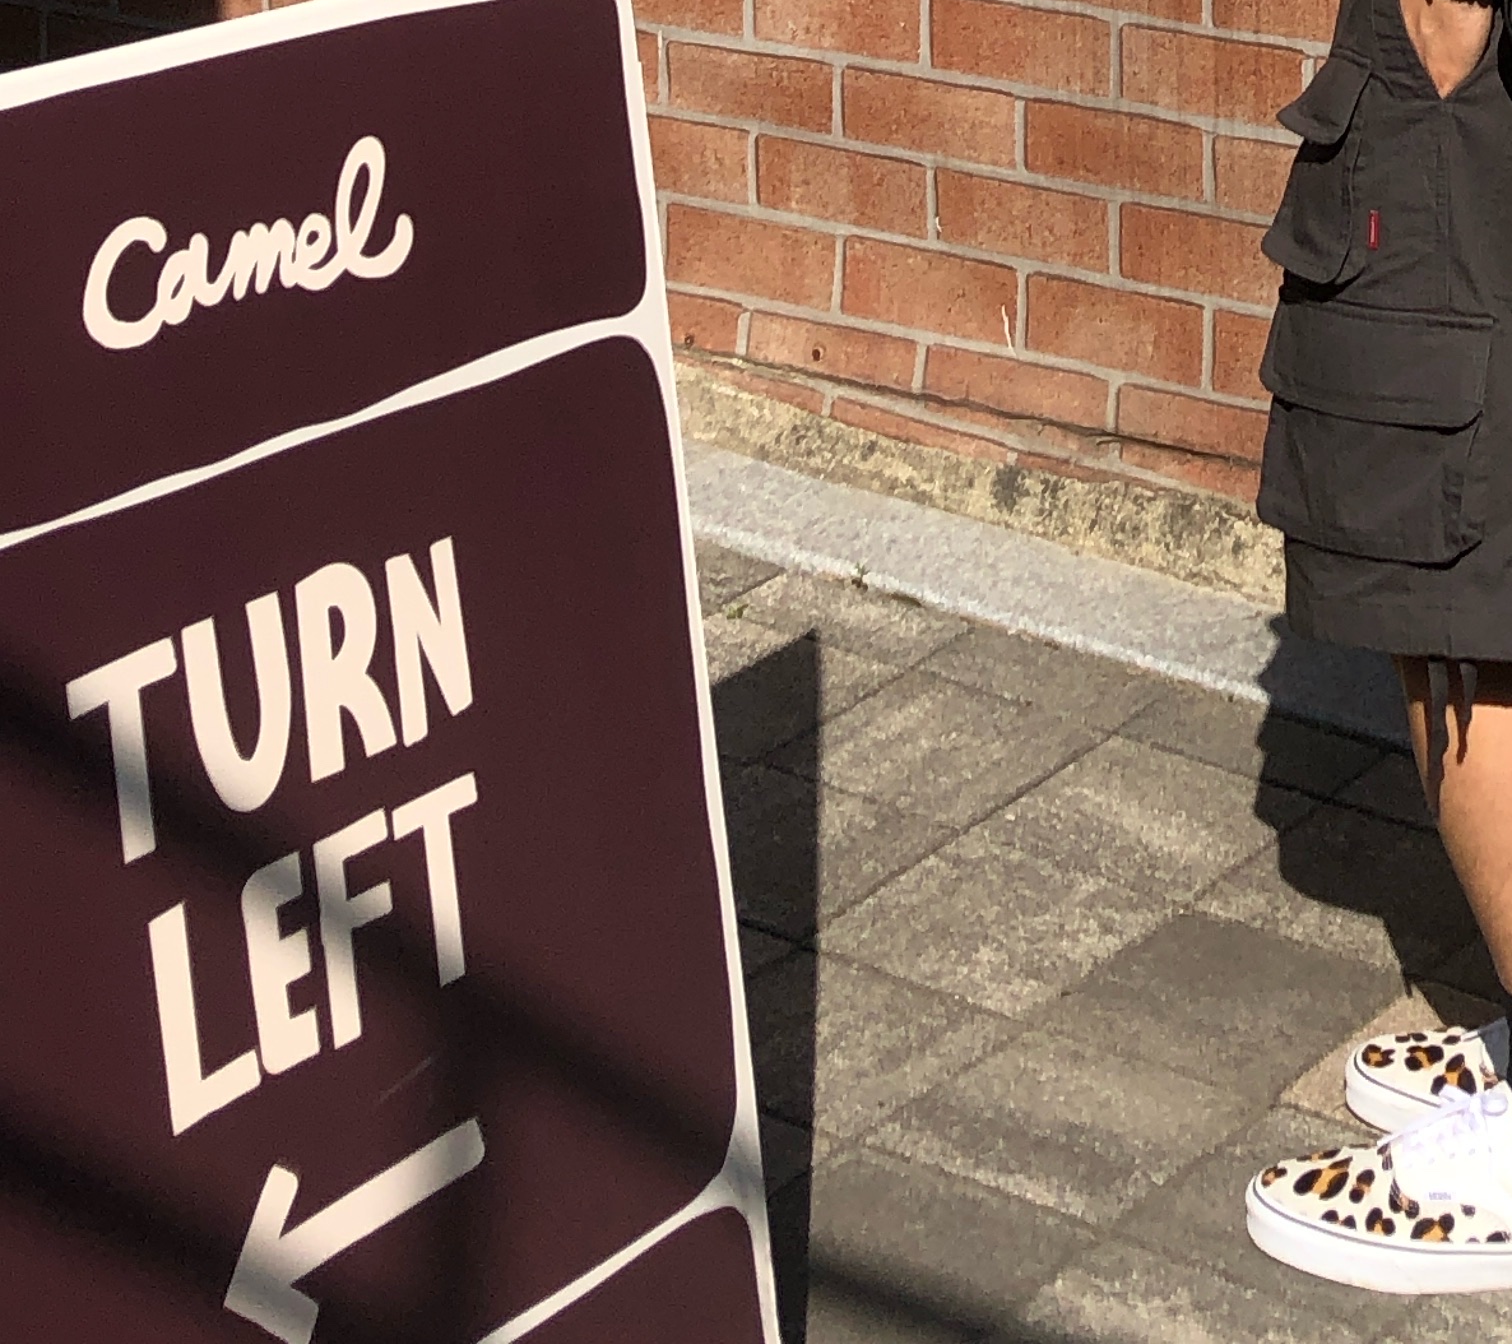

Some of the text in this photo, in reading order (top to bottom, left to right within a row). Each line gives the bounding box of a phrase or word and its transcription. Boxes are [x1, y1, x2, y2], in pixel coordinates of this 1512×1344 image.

[83, 136, 413, 349] Camel
[66, 536, 474, 864] TURN
[148, 772, 478, 1136] LEFT
